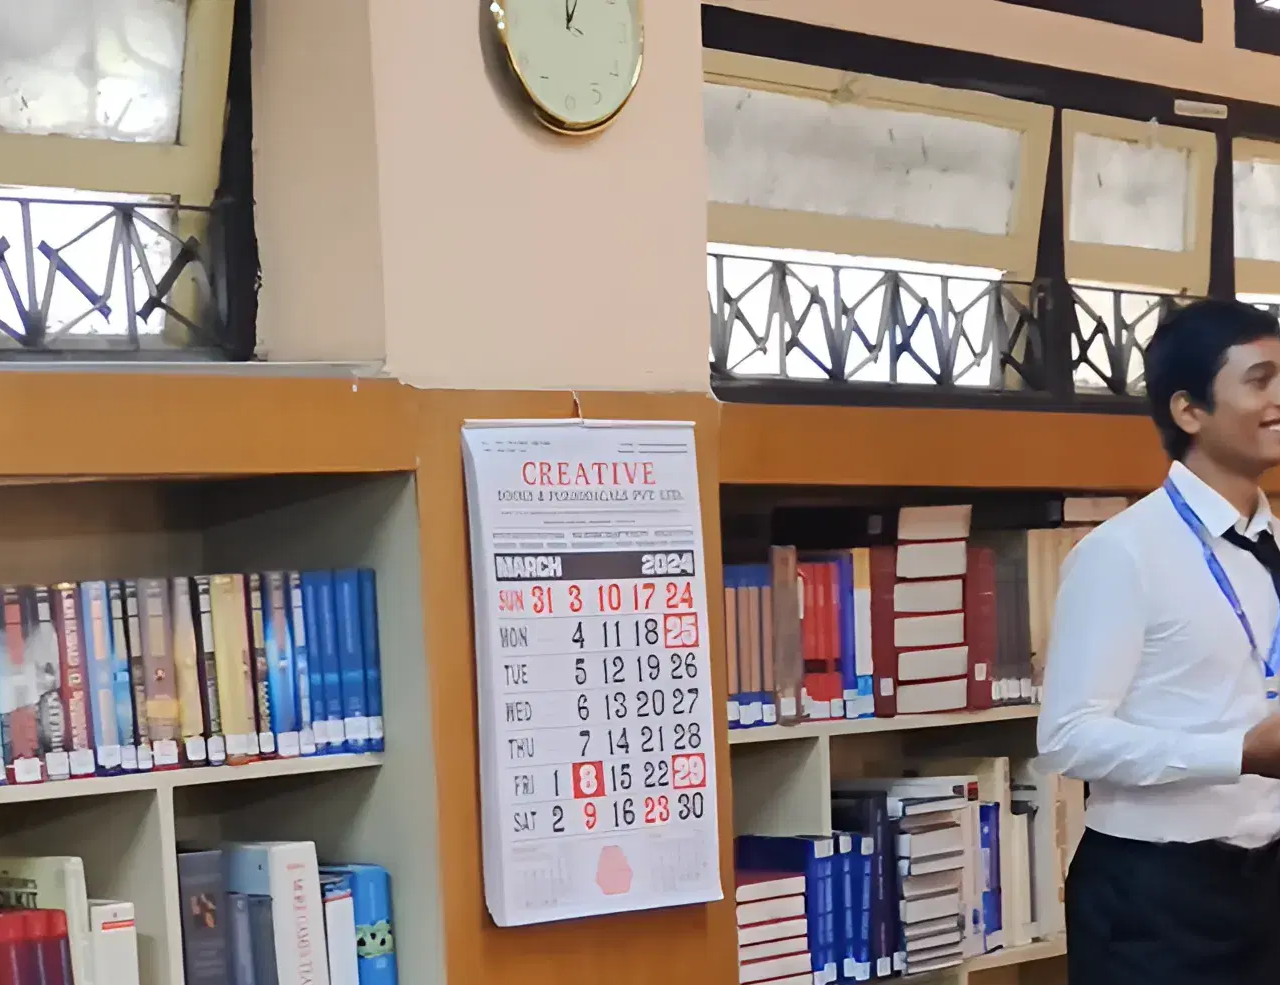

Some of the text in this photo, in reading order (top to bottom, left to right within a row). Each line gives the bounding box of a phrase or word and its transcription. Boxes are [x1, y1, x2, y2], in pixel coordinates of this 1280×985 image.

[522, 461, 656, 486] CREATIVE
[495, 552, 693, 578] MARCH 2024
[531, 585, 554, 613] 31
[568, 584, 583, 612] 3
[598, 583, 622, 612] 10
[633, 582, 656, 610] 17
[665, 581, 693, 609] 24
[572, 621, 585, 648] 4
[602, 620, 622, 648] 11
[635, 618, 659, 646] 18
[664, 614, 698, 647] 25
[504, 652, 698, 686] TUE 5 12 19 26
[505, 688, 699, 722] WED 6 13 20 27
[579, 730, 590, 756] 7
[608, 727, 629, 755] 14
[641, 725, 664, 752] 21
[673, 722, 701, 750] 28
[579, 764, 598, 795] 8
[611, 763, 632, 792] 15
[643, 760, 669, 788] 22
[673, 755, 705, 787] 29
[514, 791, 704, 833] SAT 2 9 16 23 30
